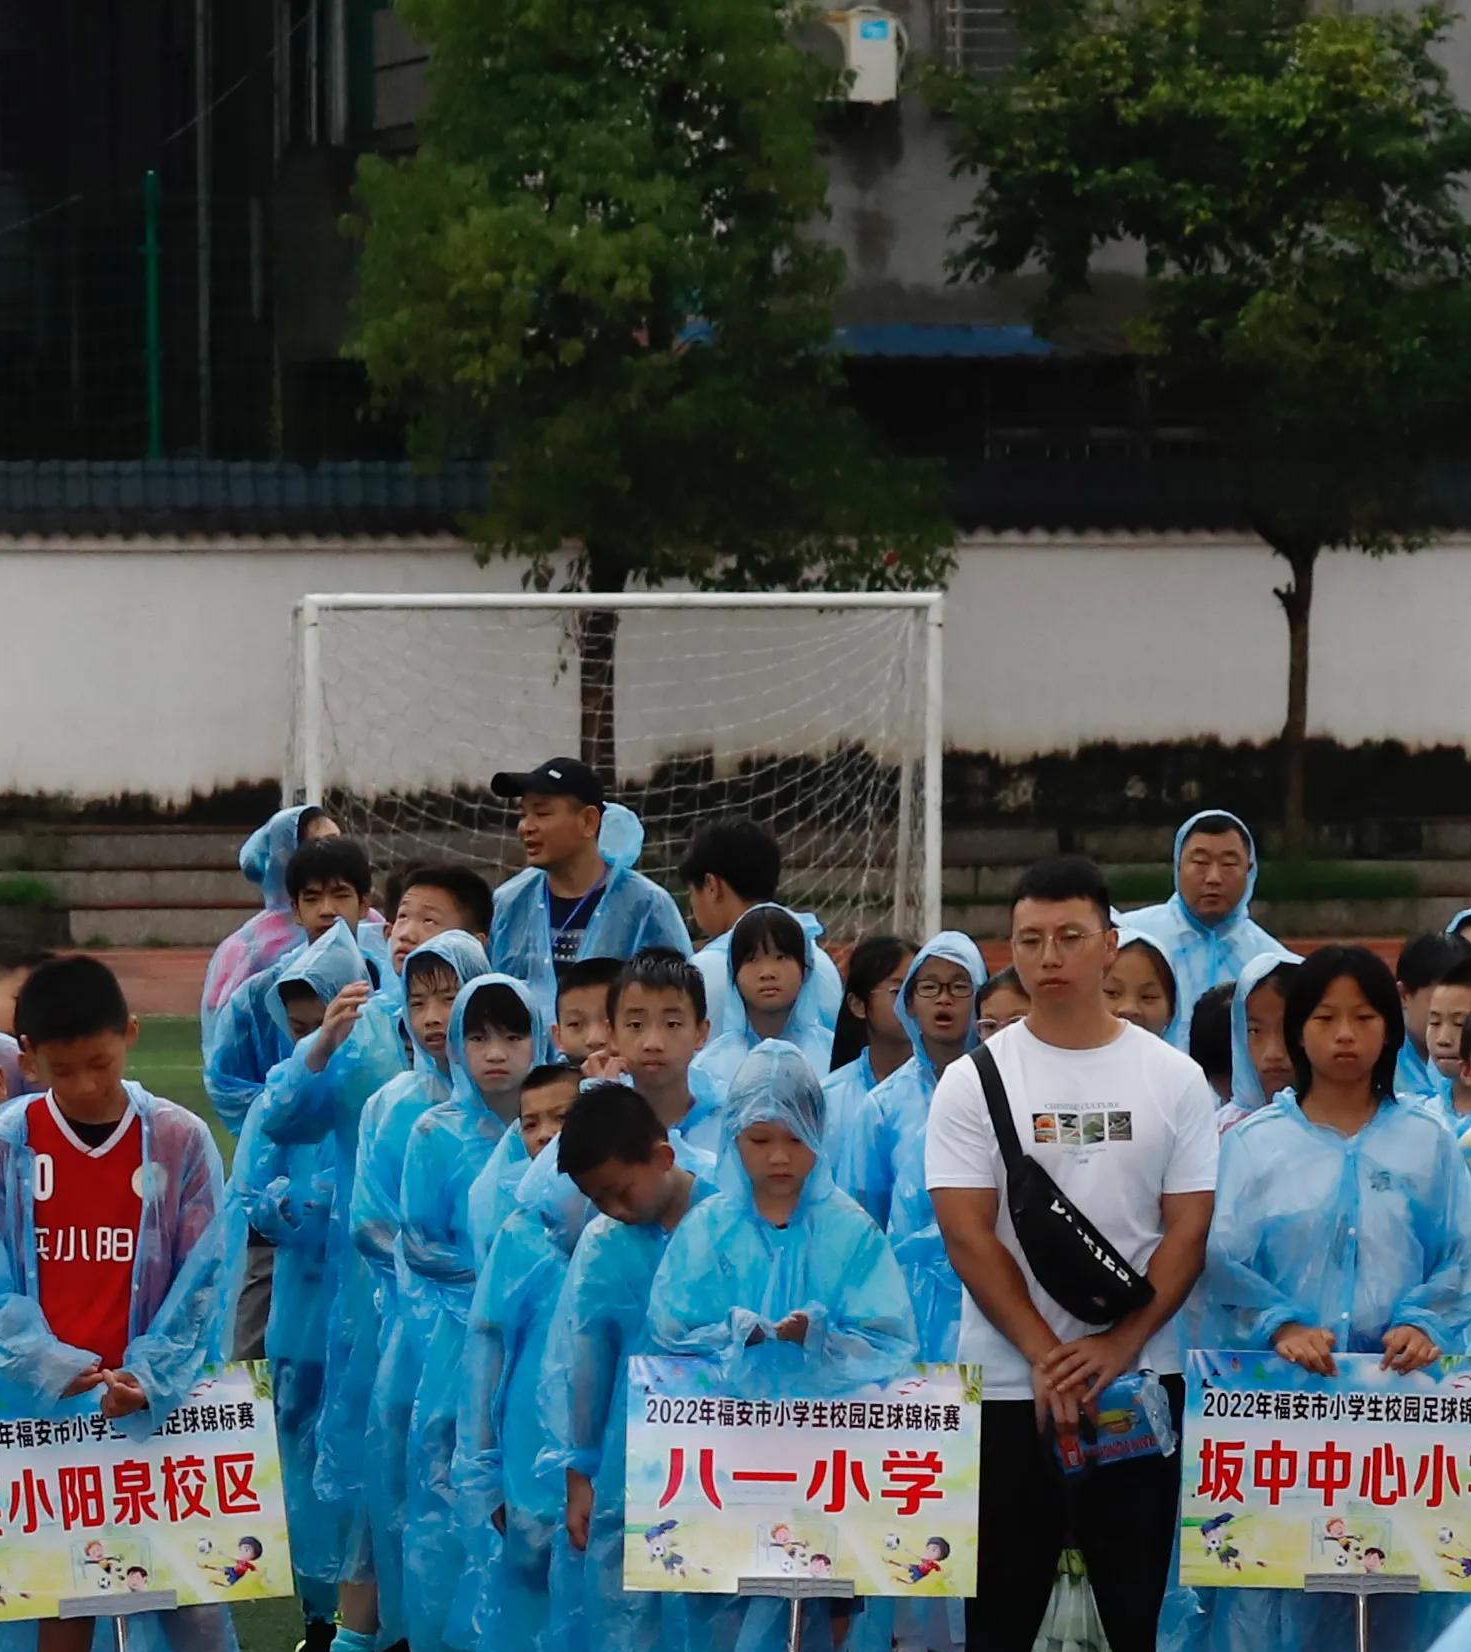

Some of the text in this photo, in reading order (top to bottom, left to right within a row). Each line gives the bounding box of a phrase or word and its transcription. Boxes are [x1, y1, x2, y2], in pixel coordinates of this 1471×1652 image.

[646, 1399, 961, 1432] 2022年福安市小学生校园足球锦标赛
[659, 1448, 943, 1516] 八一小学
